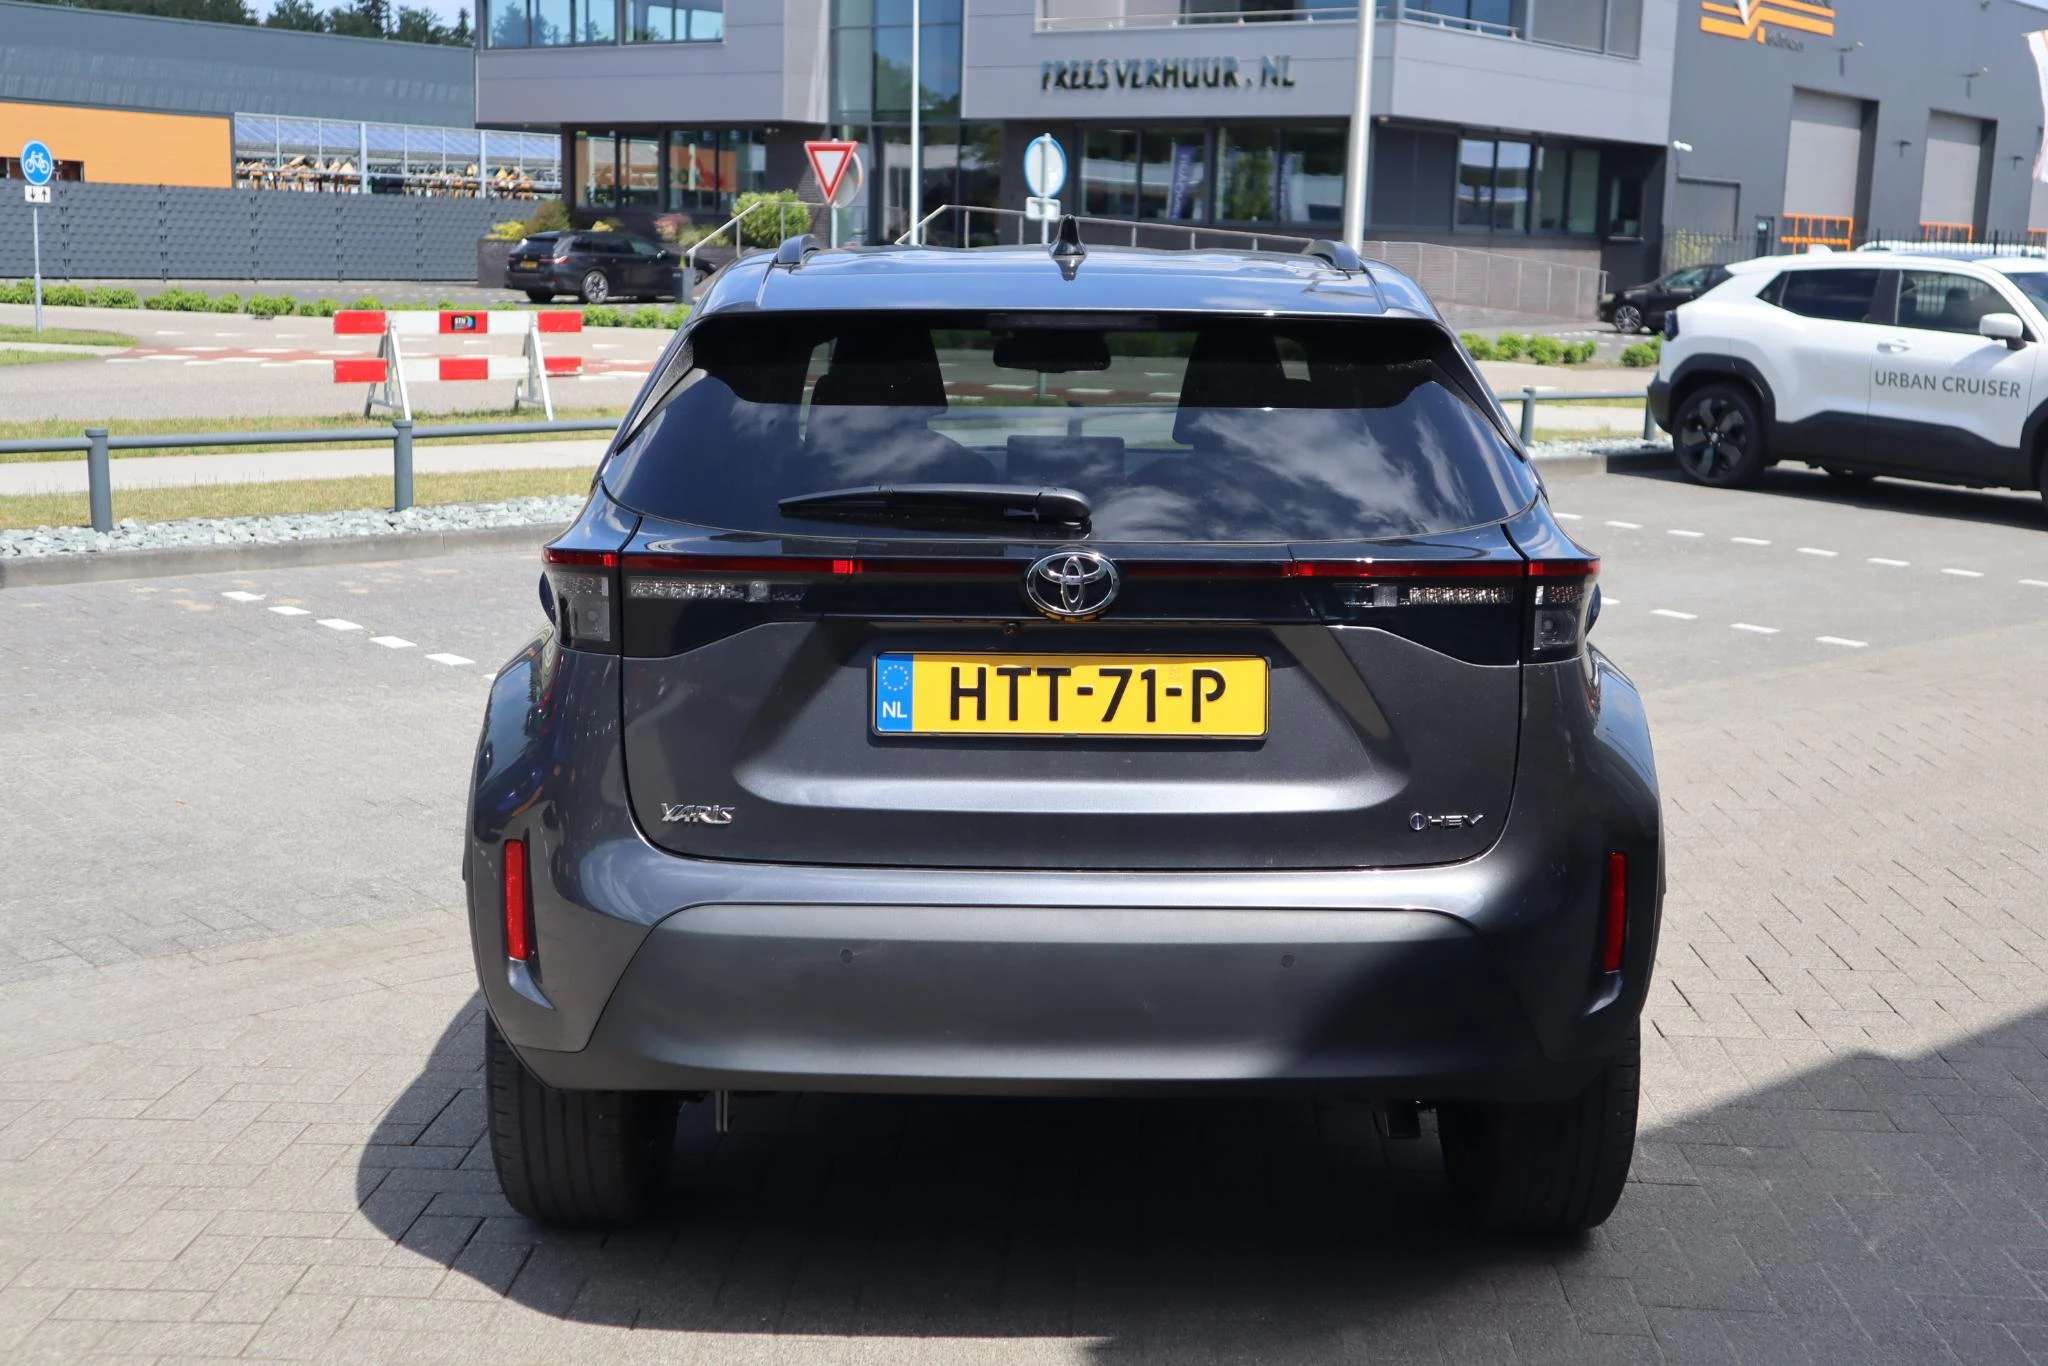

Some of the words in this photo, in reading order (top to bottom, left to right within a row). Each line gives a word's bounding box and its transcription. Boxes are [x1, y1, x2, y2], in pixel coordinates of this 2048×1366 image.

[1875, 370, 1937, 391] URBAN
[1942, 376, 2022, 399] CRUISER
[950, 666, 1227, 723] HTT-71-P
[882, 701, 908, 719] NL
[1427, 814, 1484, 829] HEV
